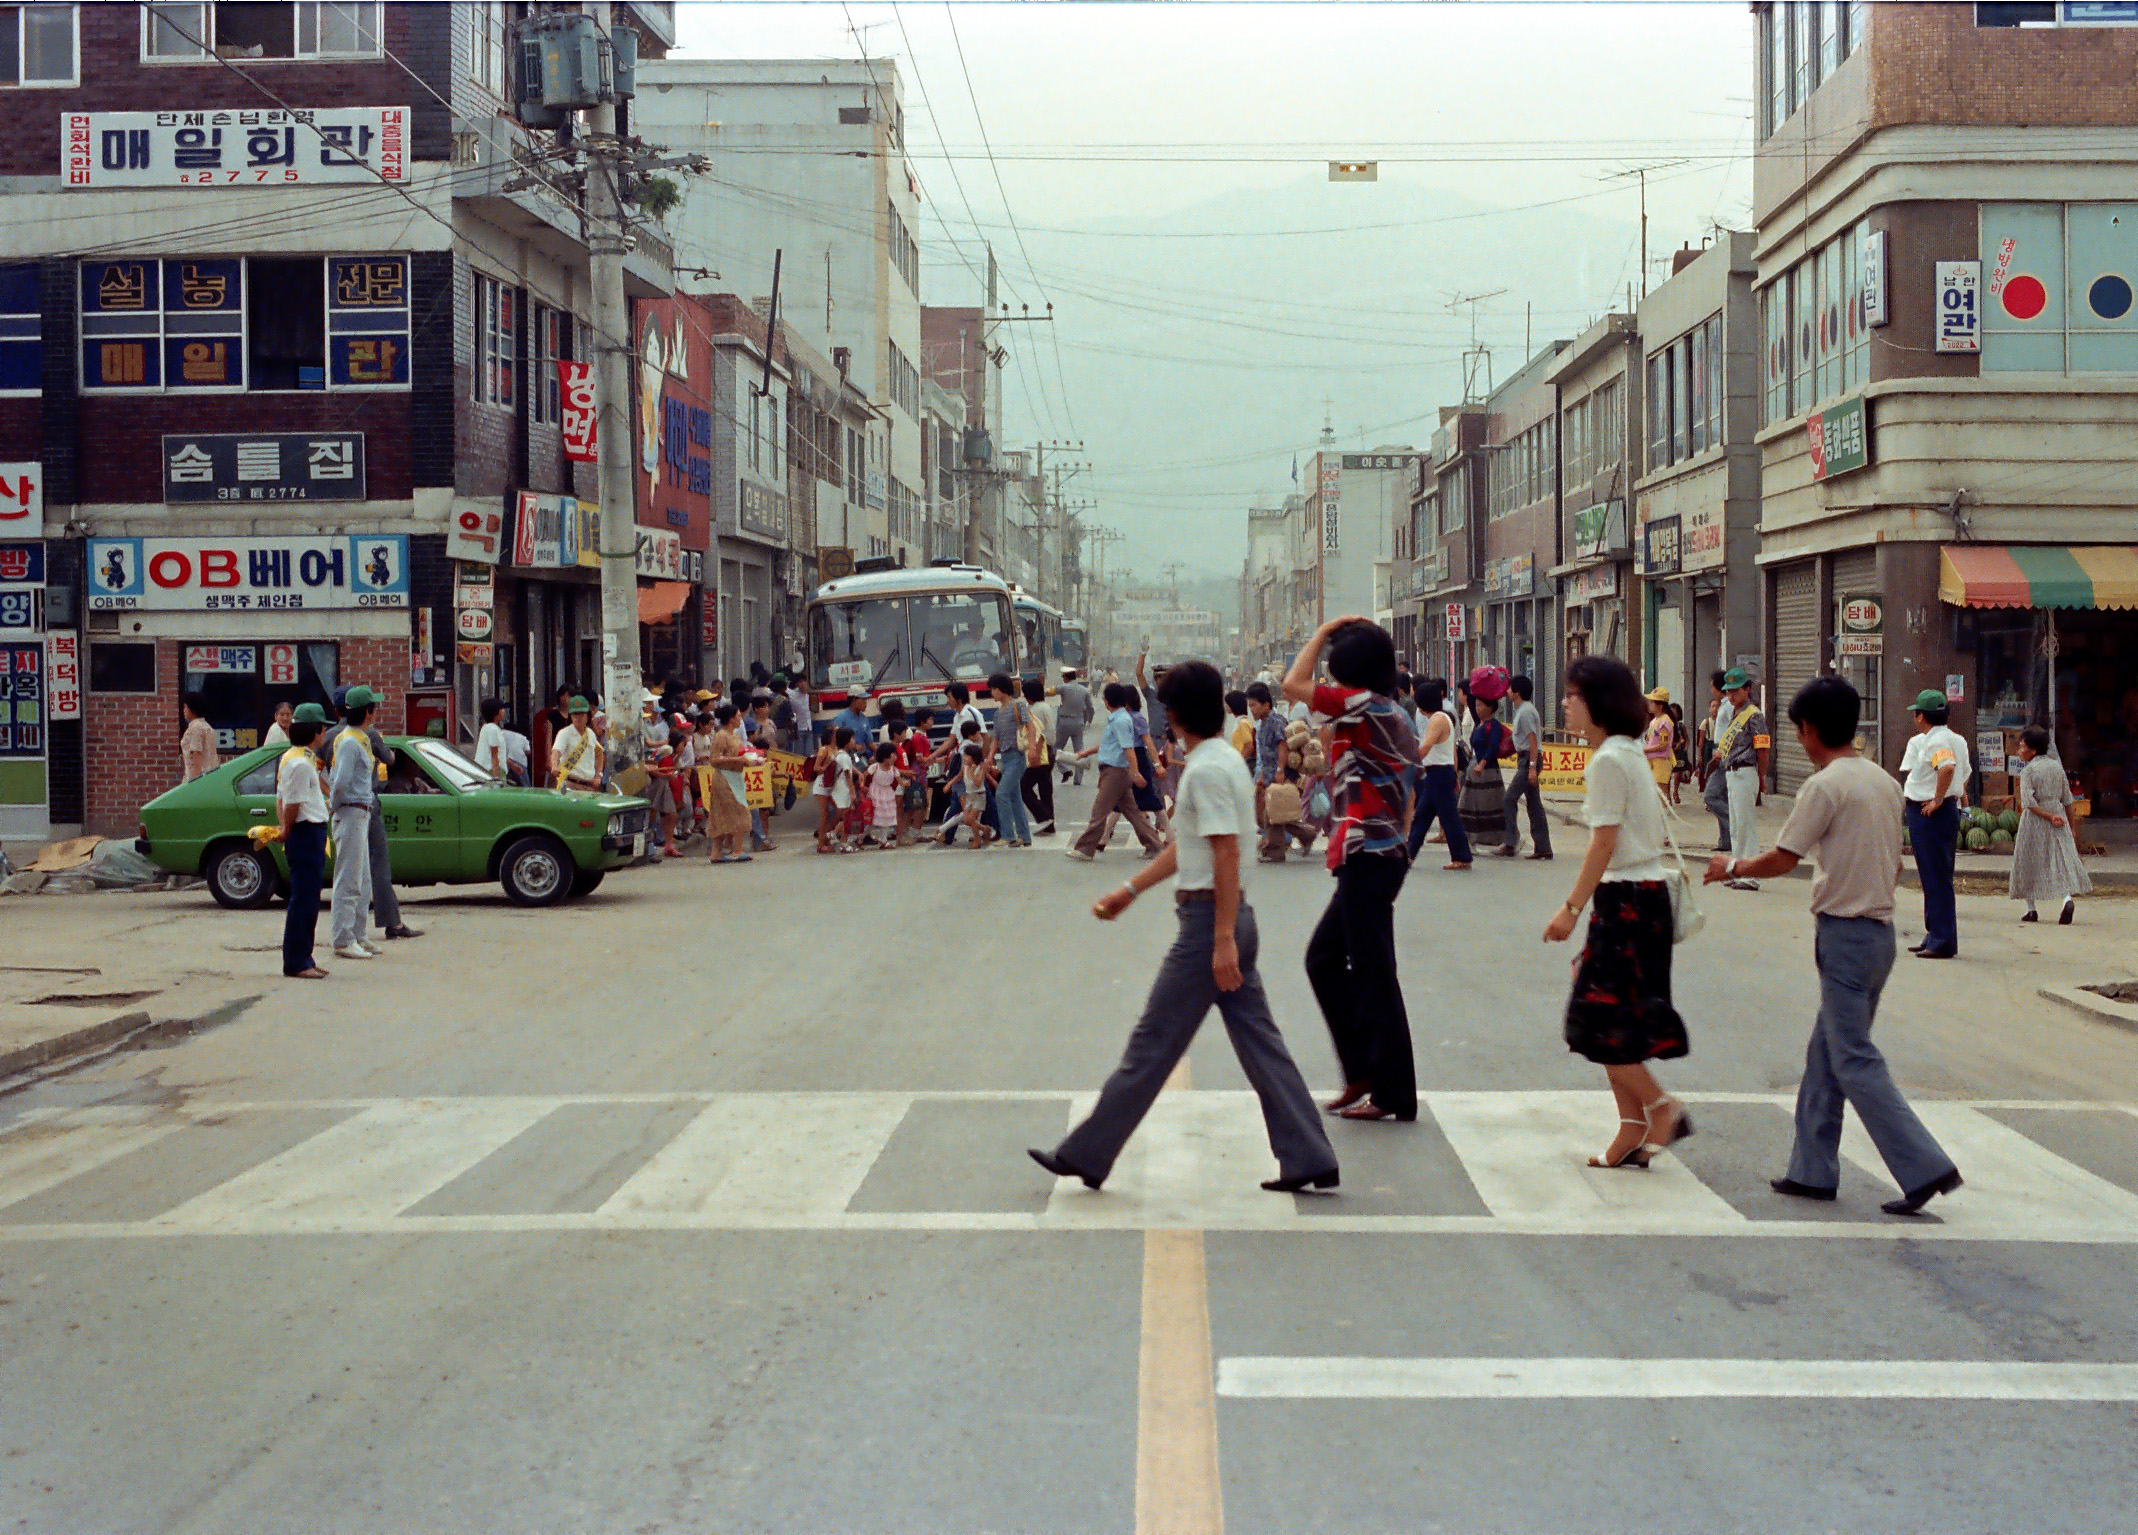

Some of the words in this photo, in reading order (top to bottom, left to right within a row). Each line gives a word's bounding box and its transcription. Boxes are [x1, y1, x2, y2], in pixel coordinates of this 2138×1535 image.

[101, 124, 375, 170] 매일회관
[198, 170, 299, 183] 2775
[1943, 288, 1977, 337] 여관
[269, 487, 306, 499] 2774
[148, 548, 345, 588] OB베어
[205, 594, 252, 609] 생맥주
[257, 593, 303, 608] 체인점
[1848, 605, 1877, 619] 담배
[461, 614, 488, 629] 담배
[188, 647, 252, 670] 생맥주
[270, 645, 294, 682] OB
[56, 637, 80, 712] 복덕방
